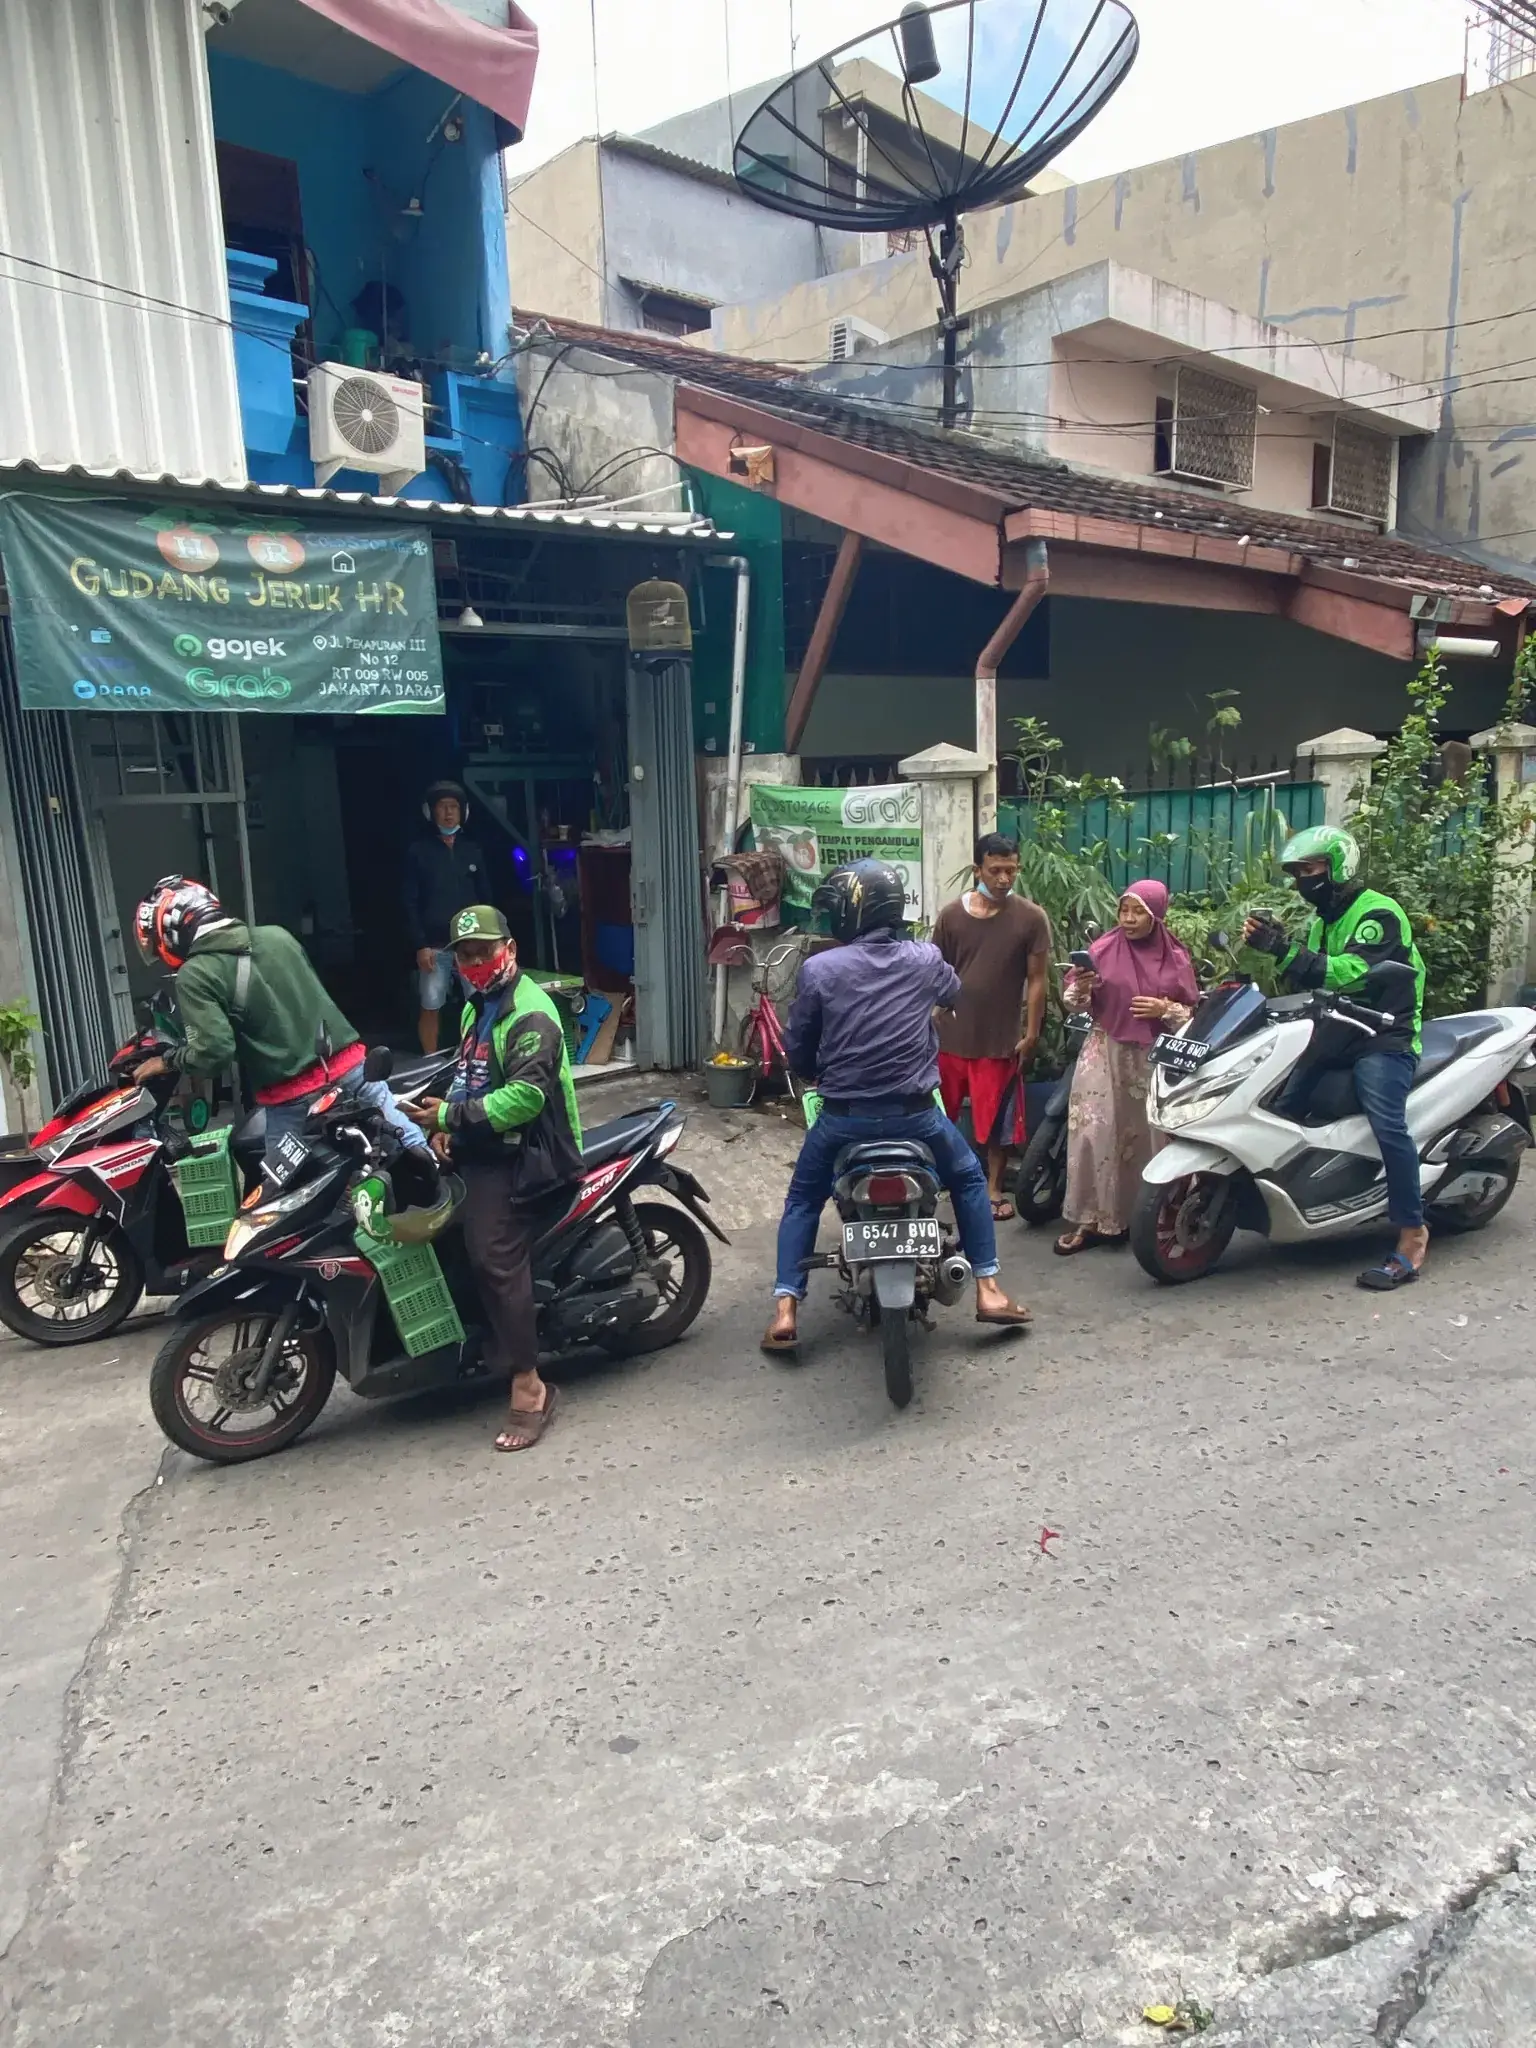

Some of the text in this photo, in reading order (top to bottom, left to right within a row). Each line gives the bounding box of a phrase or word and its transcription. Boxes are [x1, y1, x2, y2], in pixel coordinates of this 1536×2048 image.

[70, 557, 409, 616] GUDANG JERUK HR
[206, 637, 287, 660] gojek
[410, 639, 426, 651] III
[360, 652, 399, 666] No 12
[332, 667, 429, 681] RT 009 RW 005
[99, 684, 152, 697] DANA
[185, 667, 292, 699] Grab
[319, 682, 442, 697] JAKARTA BARAT
[845, 786, 921, 824] Grab
[817, 835, 852, 846] TEMPAT
[846, 1226, 855, 1242] B
[862, 1222, 899, 1240] 6547
